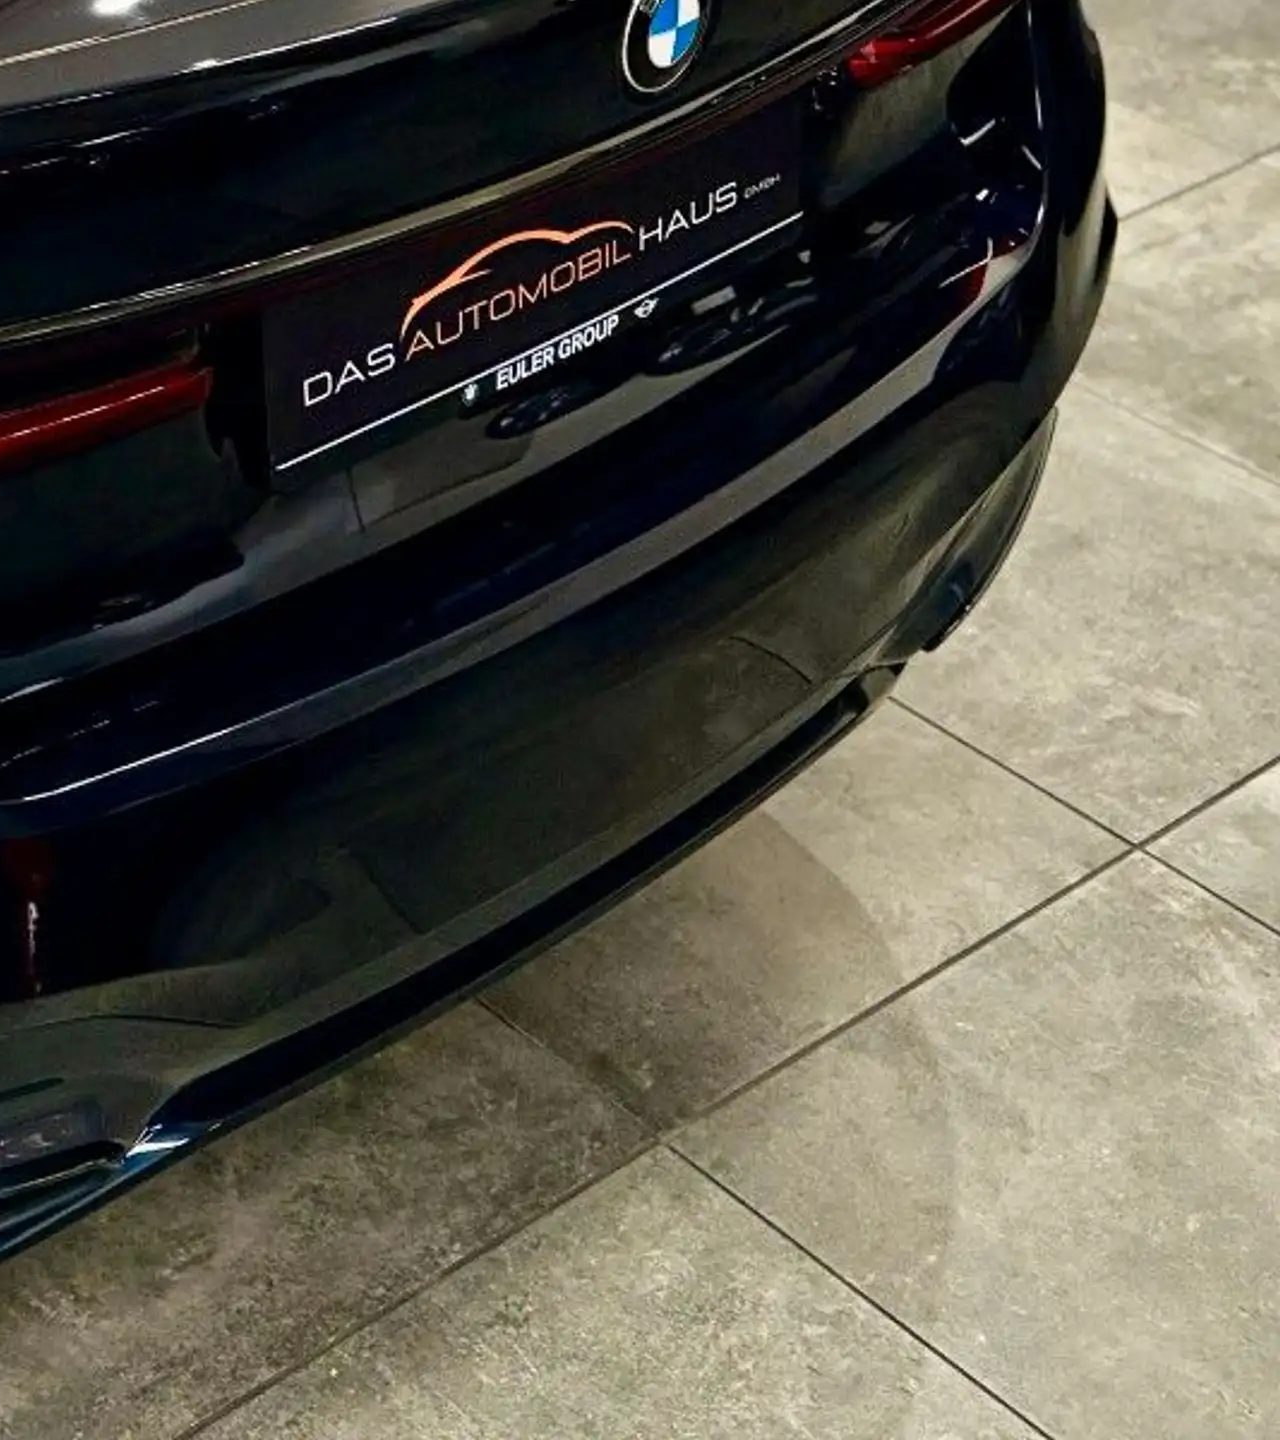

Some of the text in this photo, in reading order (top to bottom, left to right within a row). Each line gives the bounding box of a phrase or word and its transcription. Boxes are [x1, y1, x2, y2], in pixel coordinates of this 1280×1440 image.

[303, 343, 396, 407] DAS
[405, 240, 632, 363] AUTOMOBIL
[639, 182, 737, 251] HAUS
[496, 314, 620, 391] EULER GROUP
